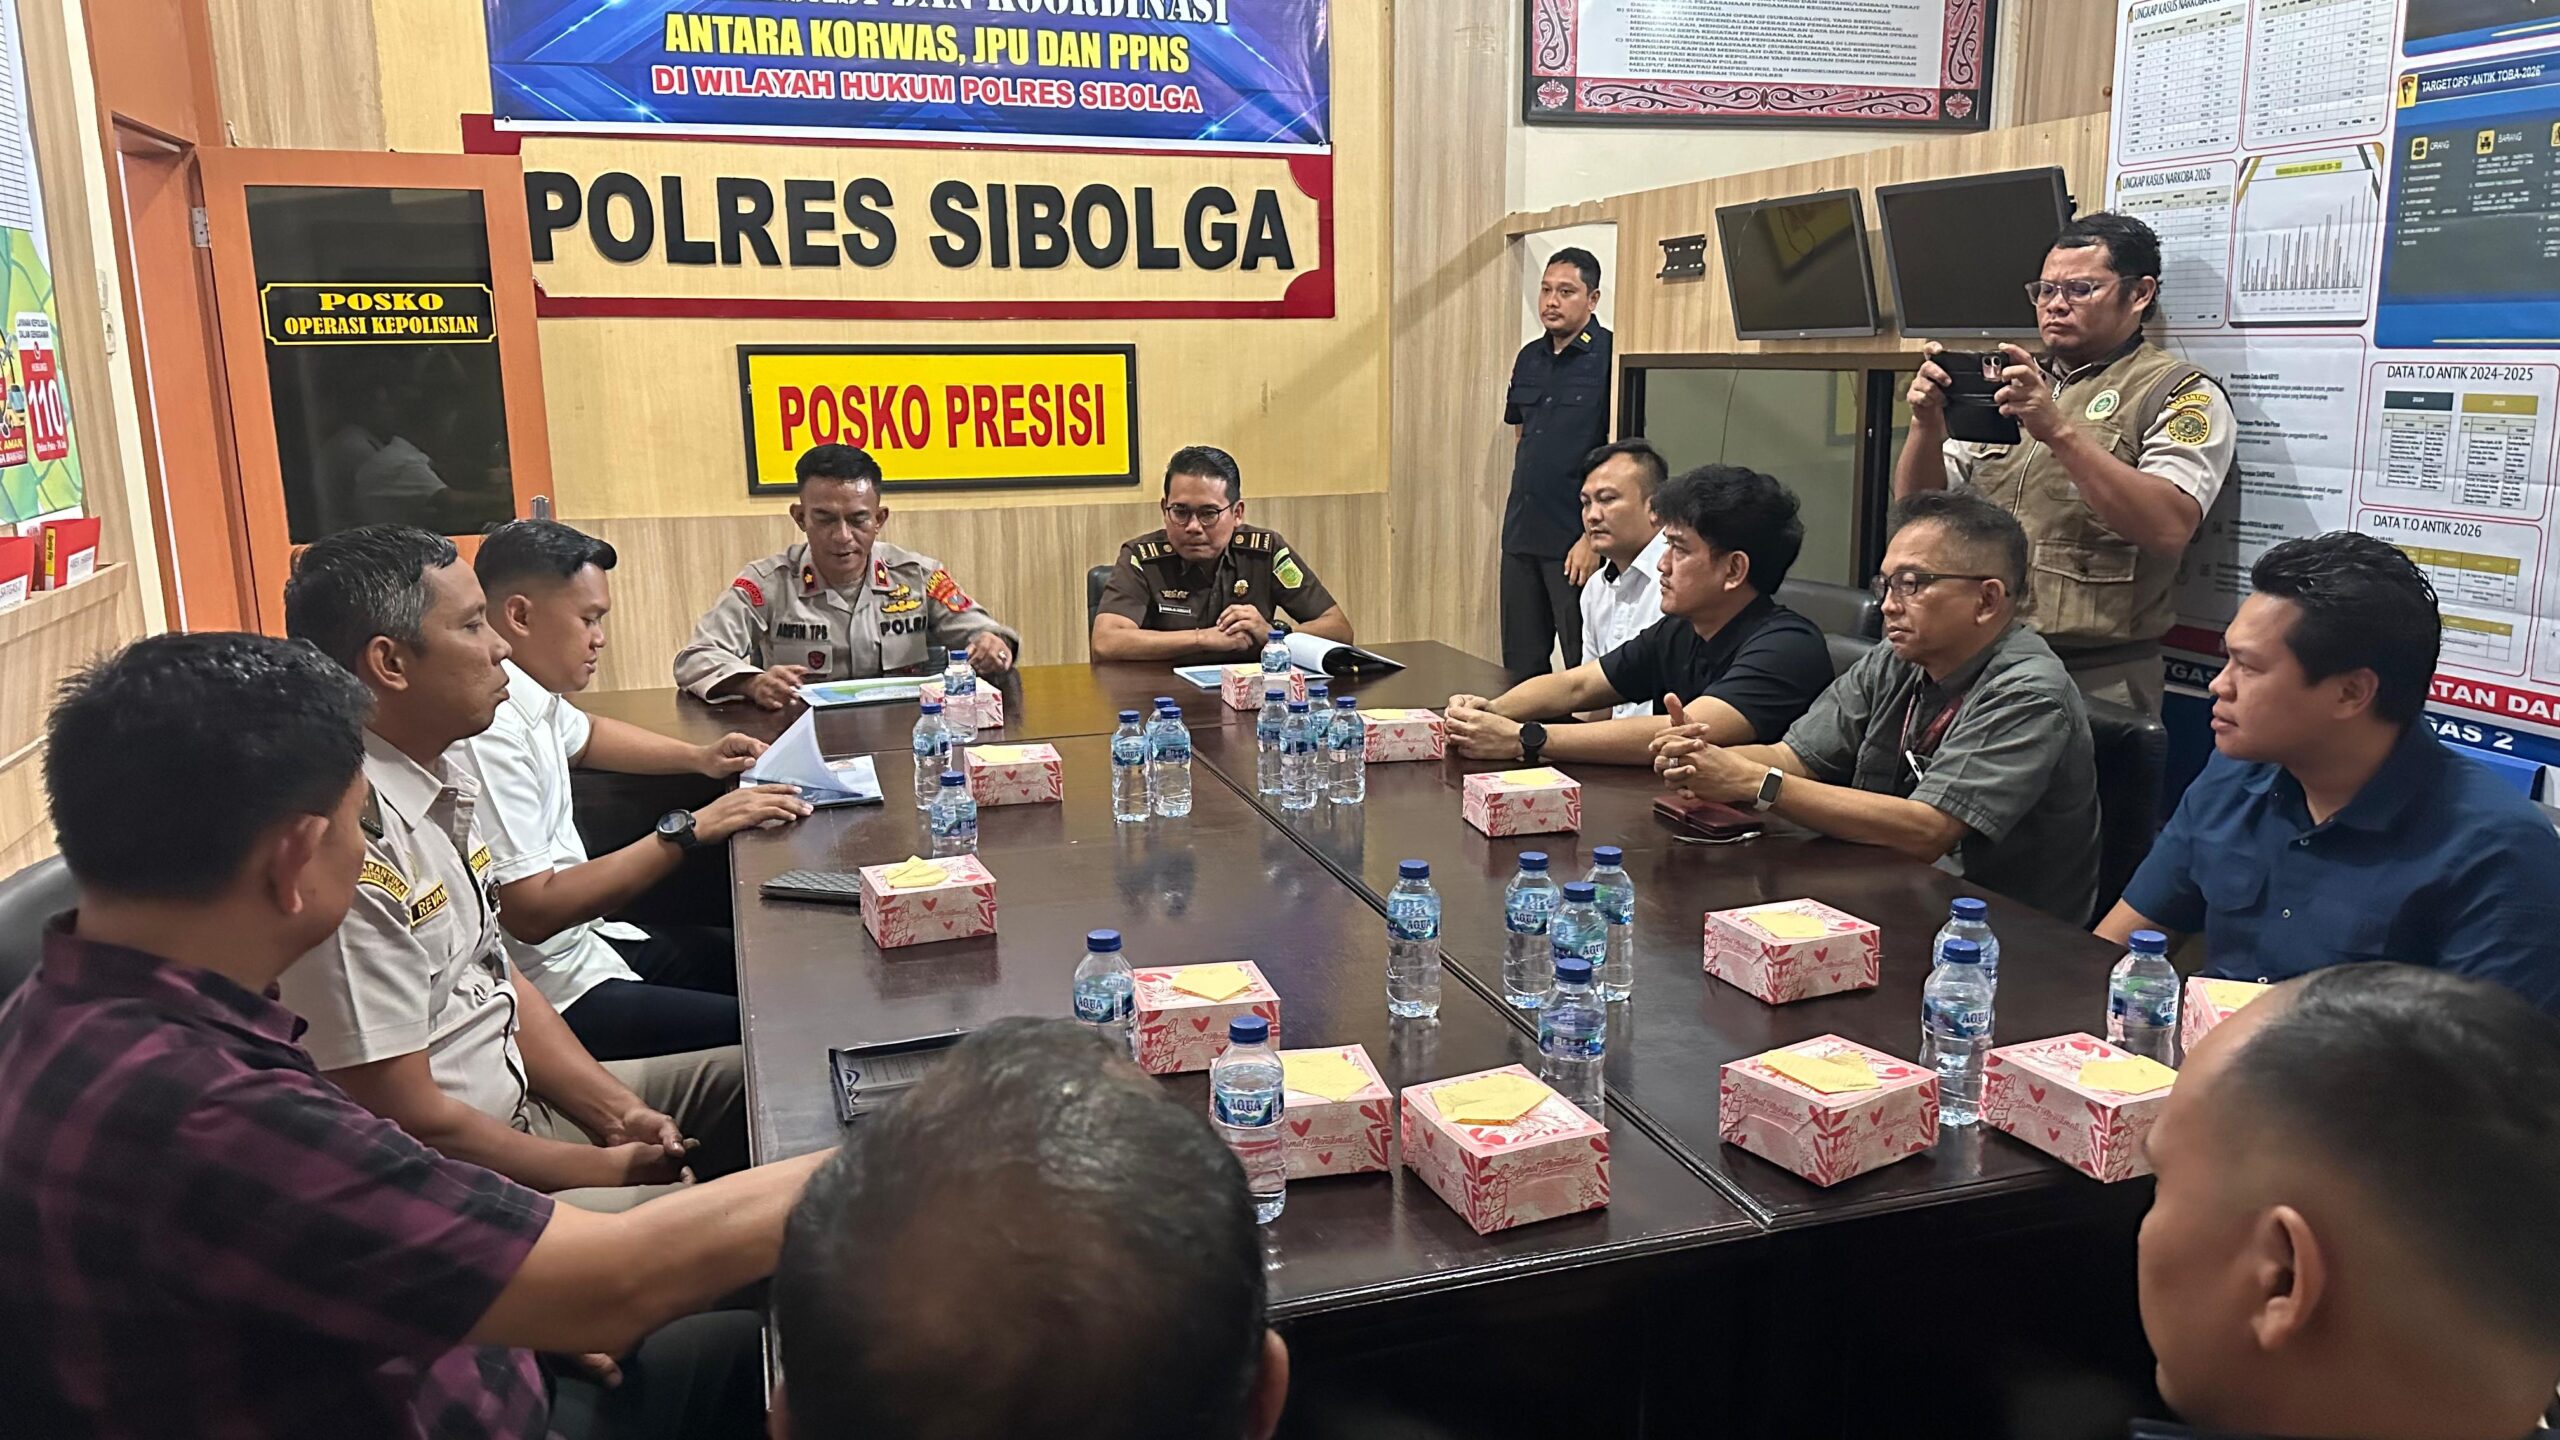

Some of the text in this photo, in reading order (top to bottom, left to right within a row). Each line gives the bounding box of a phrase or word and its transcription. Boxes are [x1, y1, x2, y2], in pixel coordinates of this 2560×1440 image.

[665, 13, 1190, 73] ANTARA KORWAS, JPU DAN PPNS
[652, 65, 1203, 114] DI WILAYAH HUKUM POLRES SIBOLGA
[2422, 78, 2451, 93] TARGET
[2146, 173, 2164, 186] KASUS
[2165, 170, 2194, 184] NARKOBA
[2194, 168, 2211, 181] 2026
[524, 171, 1295, 270] POLRES SIBOLGA
[318, 293, 444, 311] POSKO
[284, 316, 478, 335] OPERASI KEPOLISIAN
[2387, 366, 2415, 379] DATA
[2418, 366, 2434, 379] T.O
[2436, 366, 2468, 380] ANTIK
[28, 379, 63, 438] 110
[778, 383, 1105, 451] POSKO PRESISI
[2373, 515, 2482, 538] DATA T.O ANTIK 2026
[880, 616, 926, 636] POLRI
[2428, 680, 2496, 708] TAN
[2492, 731, 2514, 750] 2
[1406, 919, 1432, 932] AQUA
[1514, 912, 1538, 925] AQUA
[1078, 997, 1104, 1011] AQUA
[1961, 1012, 1988, 1025] AQUA
[1229, 1098, 1262, 1114] AQUA
